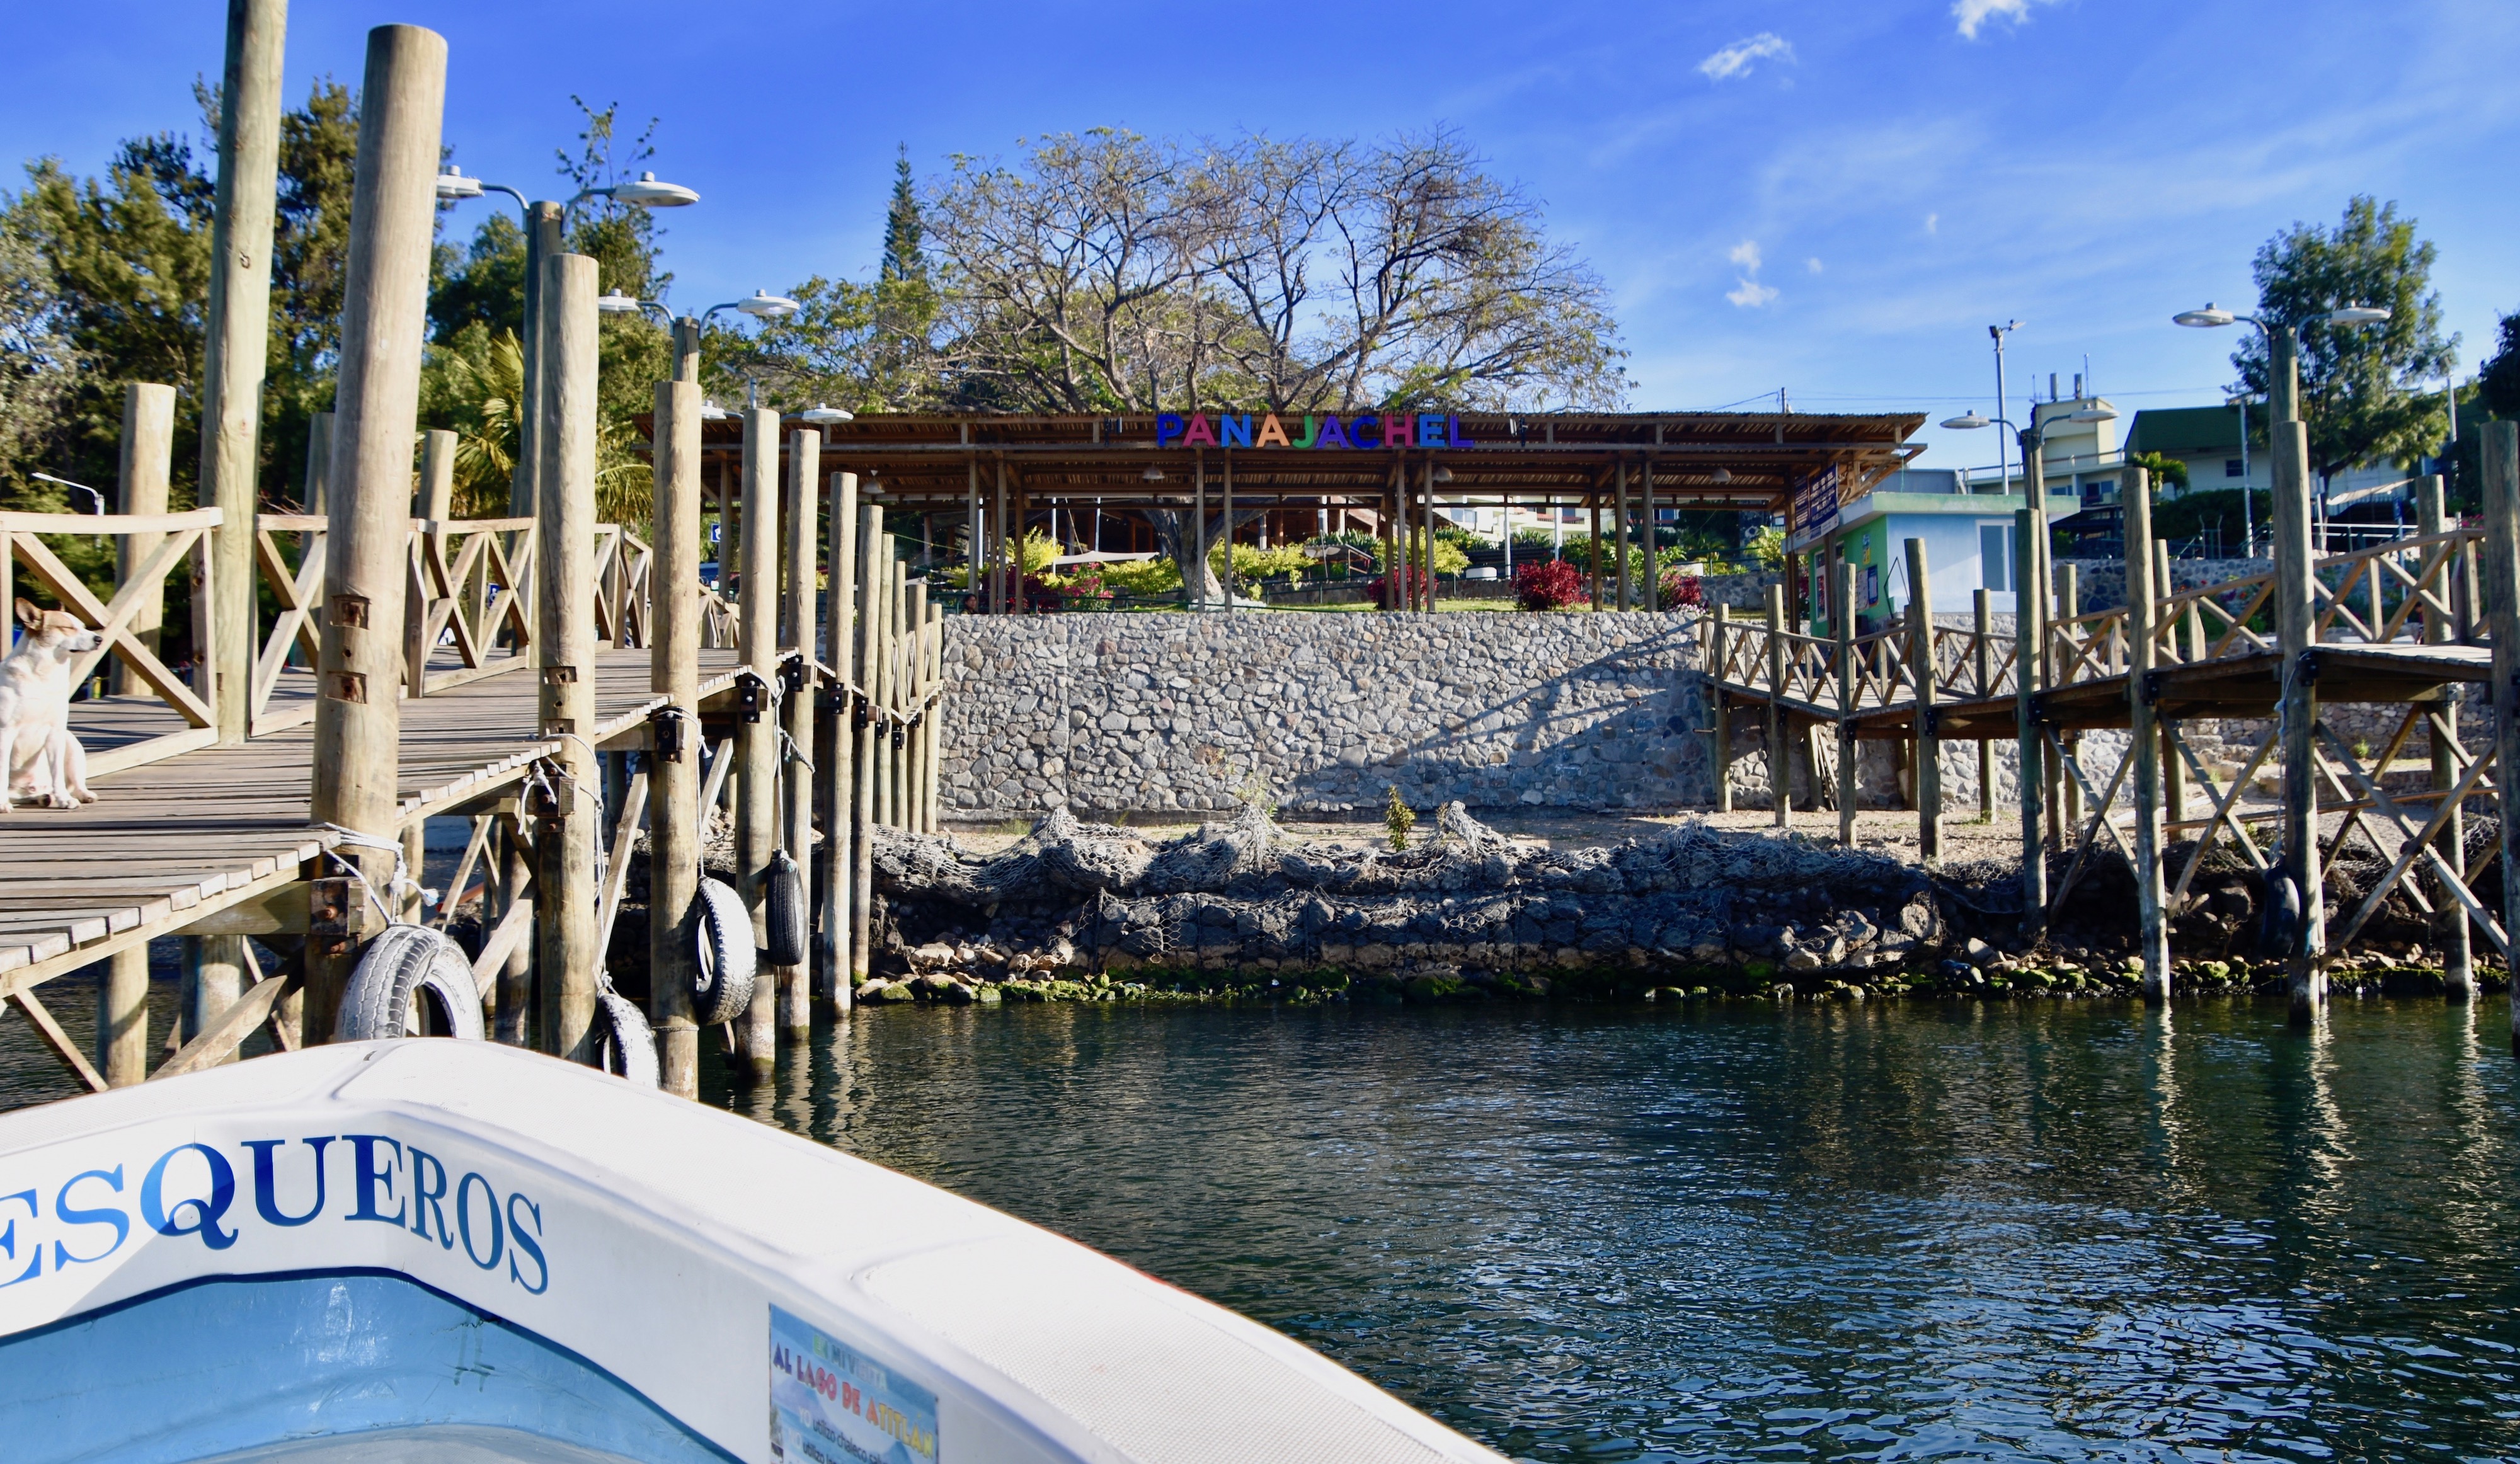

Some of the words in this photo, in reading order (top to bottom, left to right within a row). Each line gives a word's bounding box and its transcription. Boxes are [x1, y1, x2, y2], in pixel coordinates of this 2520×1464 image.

[1157, 413, 1474, 449] PANAJACHEL
[832, 1344, 845, 1370] MI
[848, 1354, 888, 1393] VISITA
[773, 1342, 792, 1375] AL
[796, 1355, 837, 1401] LAGO
[842, 1381, 861, 1416] DE
[866, 1396, 934, 1460] ATITLÁN
[789, 1427, 803, 1449] NO
[799, 1407, 812, 1428] YO
[813, 1419, 836, 1443] utilizo
[837, 1431, 868, 1463] chaleco
